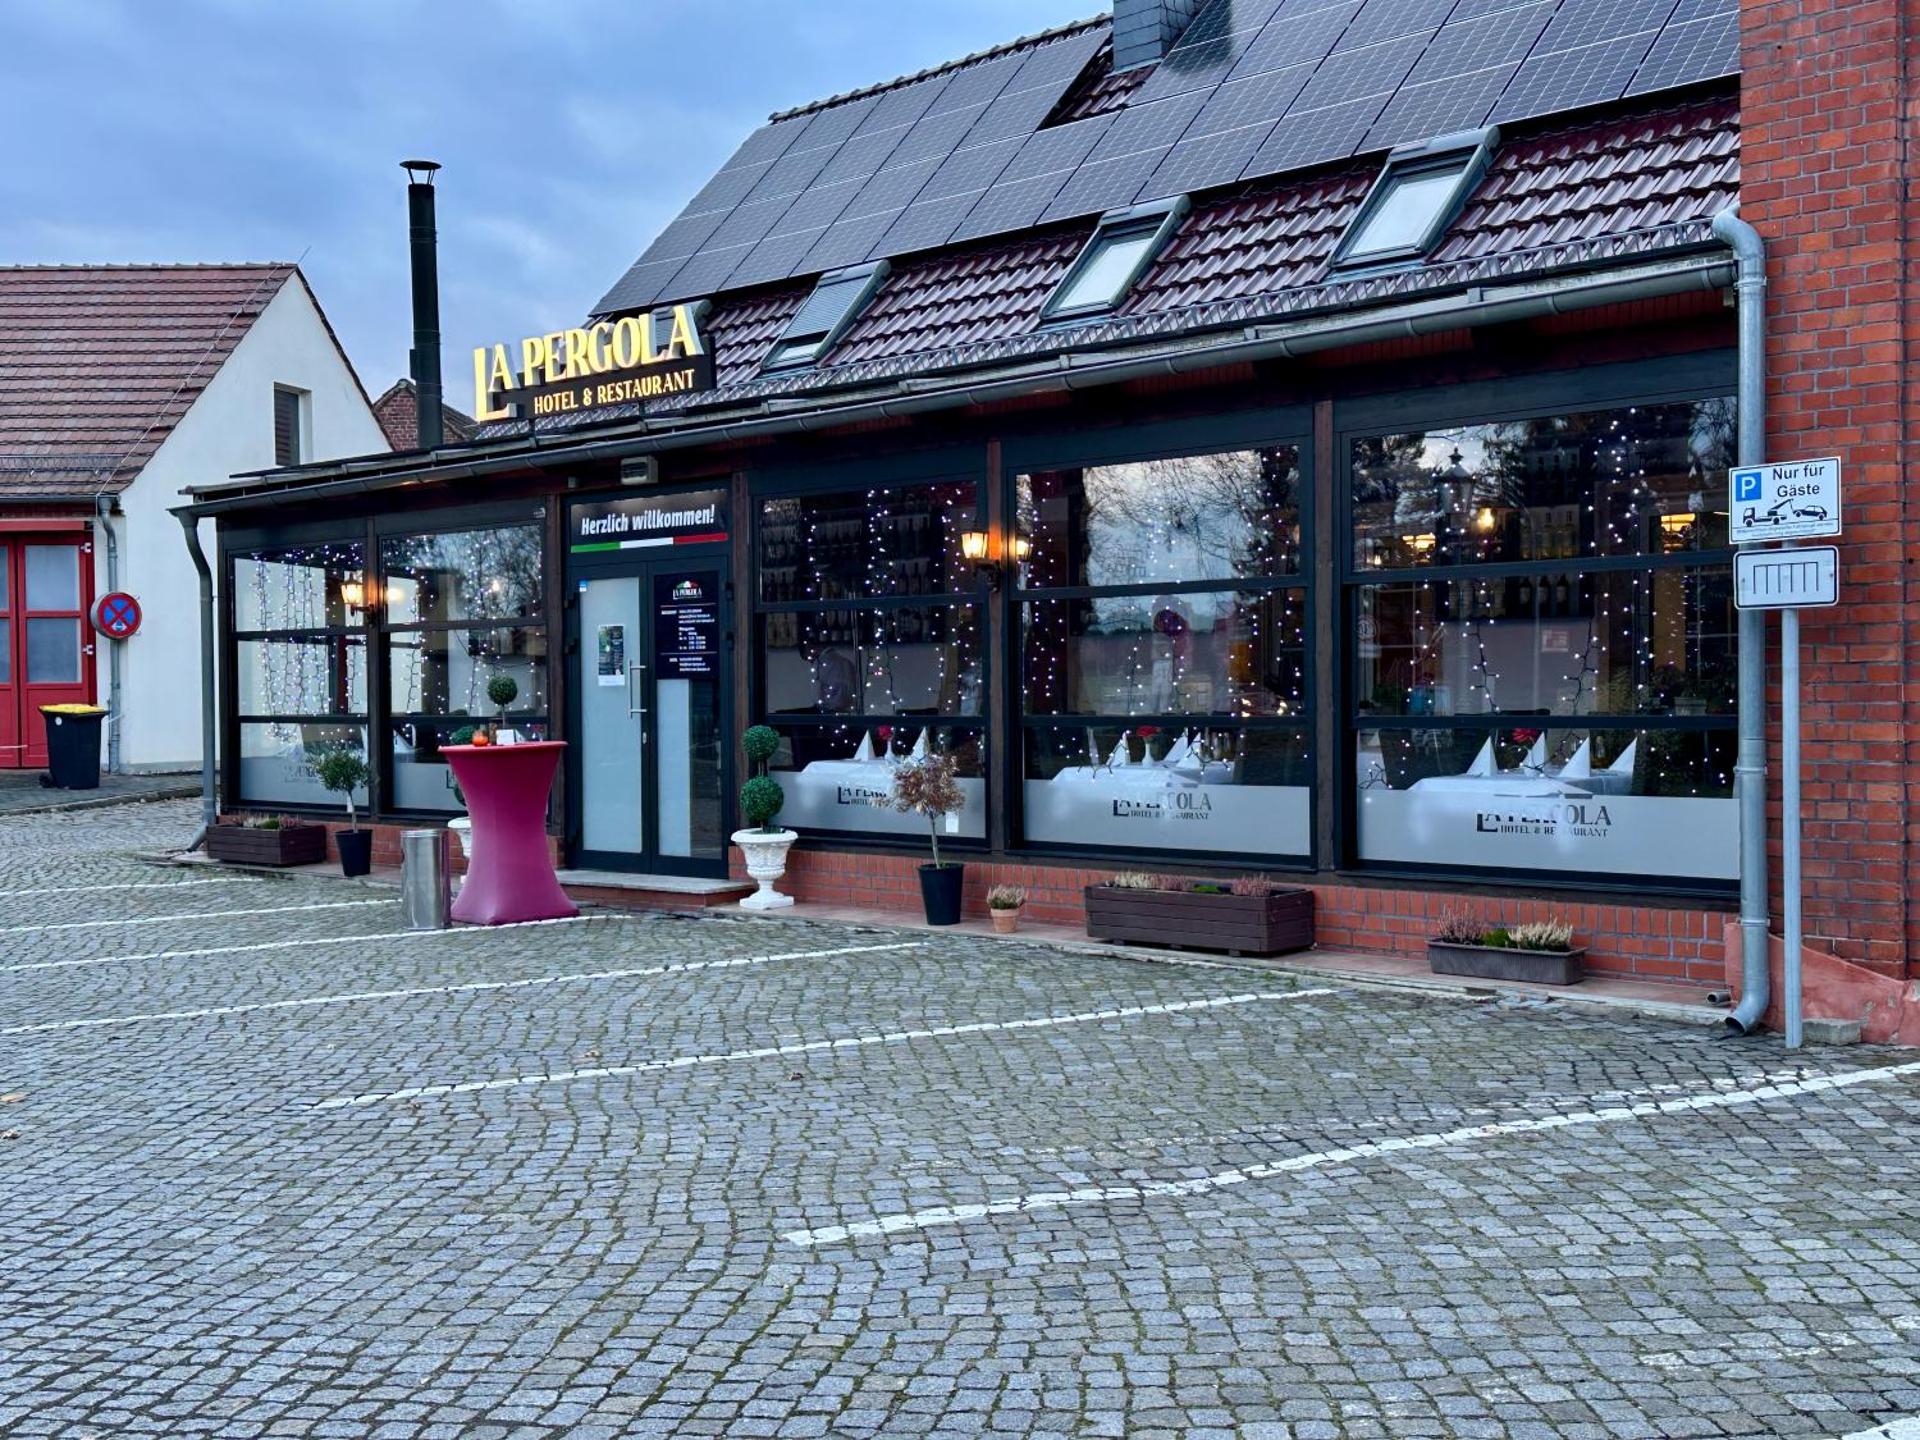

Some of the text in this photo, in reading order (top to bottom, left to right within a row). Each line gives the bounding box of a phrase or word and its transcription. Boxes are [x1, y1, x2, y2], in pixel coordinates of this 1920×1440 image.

[474, 305, 704, 422] LA PERGOLA
[534, 369, 695, 415] HOTEL & RESTAURANT
[1741, 464, 1825, 498] P Nur für
[1777, 484, 1820, 498] Gäste
[581, 504, 715, 535] Herzlich willkommen!
[1500, 825, 1530, 834] HOTEL
[1544, 825, 1609, 837] REURANT
